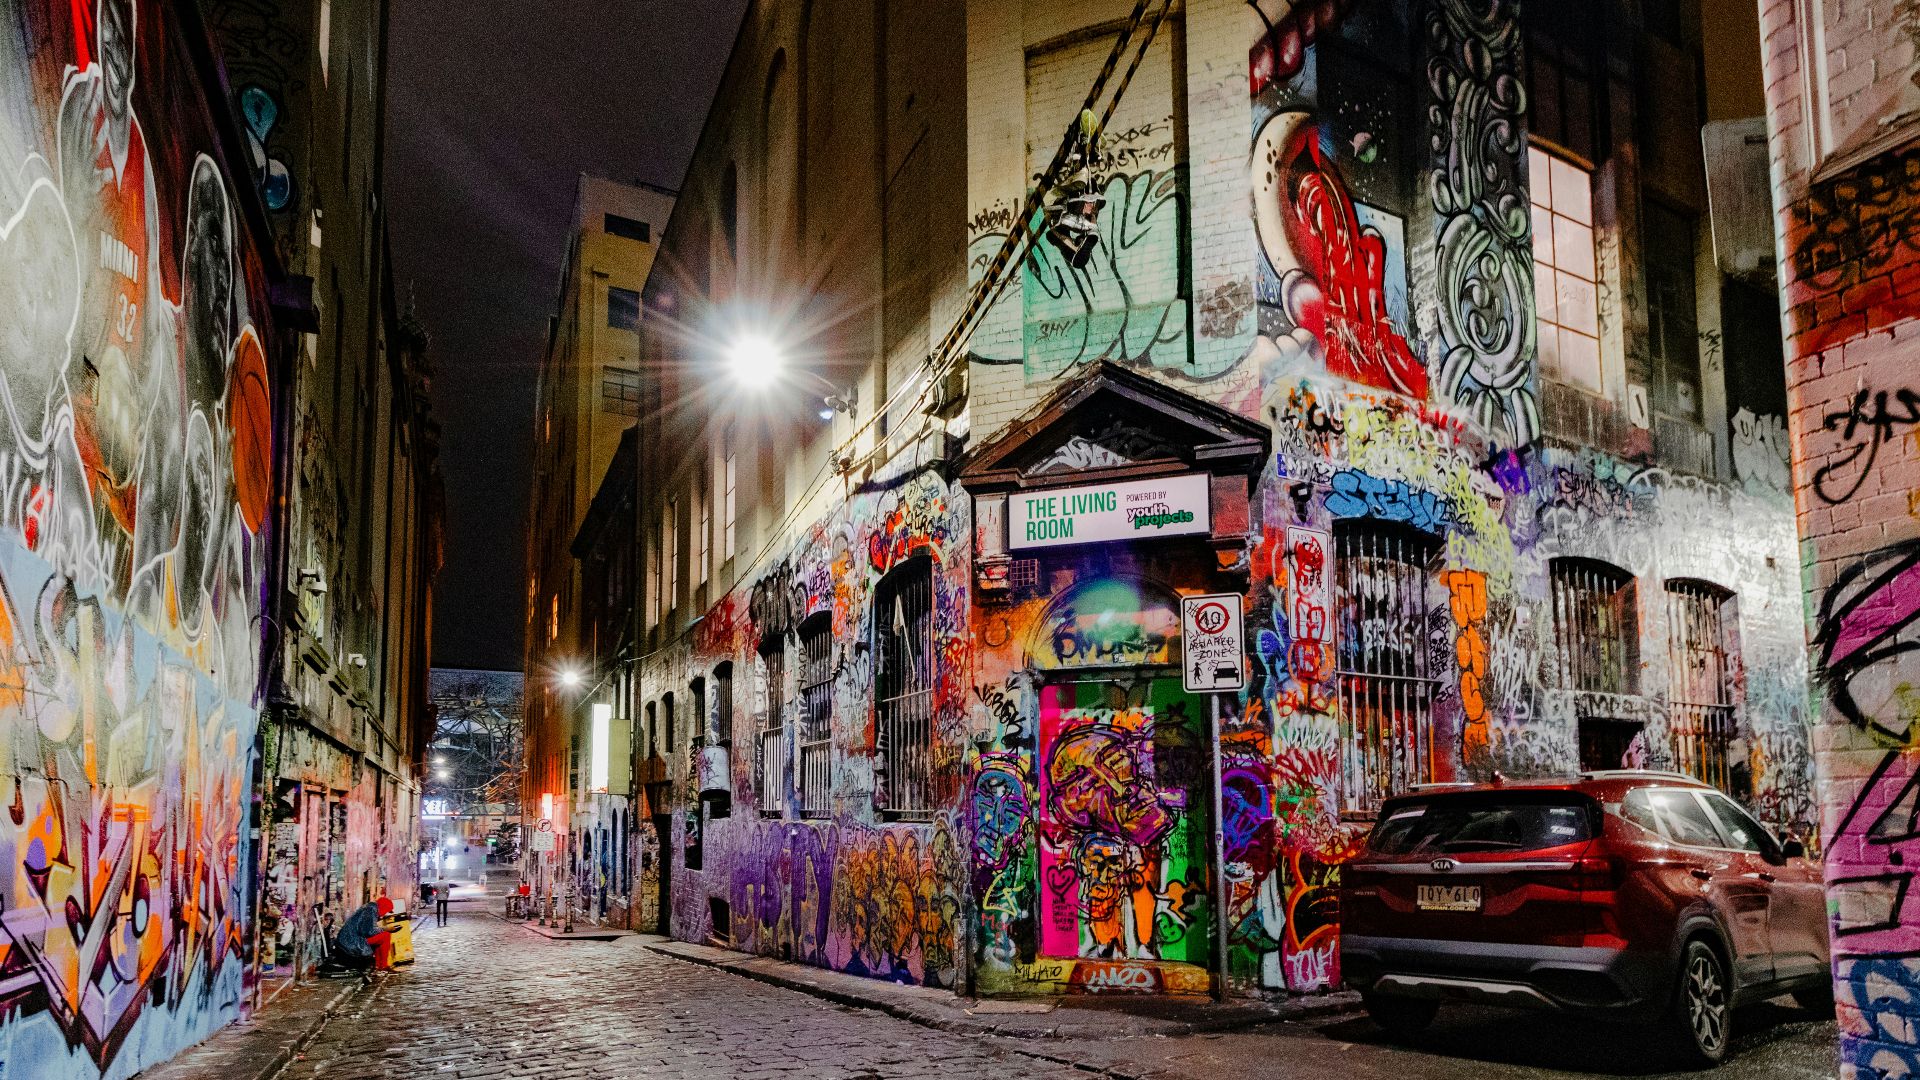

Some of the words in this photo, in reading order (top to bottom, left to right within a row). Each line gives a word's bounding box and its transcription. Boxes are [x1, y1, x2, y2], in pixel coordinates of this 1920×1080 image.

[117, 292, 137, 343] 32
[1025, 497, 1057, 520] THE
[1062, 491, 1117, 516] LIVING
[1126, 492, 1157, 503] POWERED
[1158, 490, 1167, 500] BY
[1127, 503, 1170, 523] youth
[1134, 510, 1194, 530] projects
[1026, 518, 1074, 542] ROOM
[1199, 648, 1228, 659] ZONE
[1433, 861, 1451, 870] KIA
